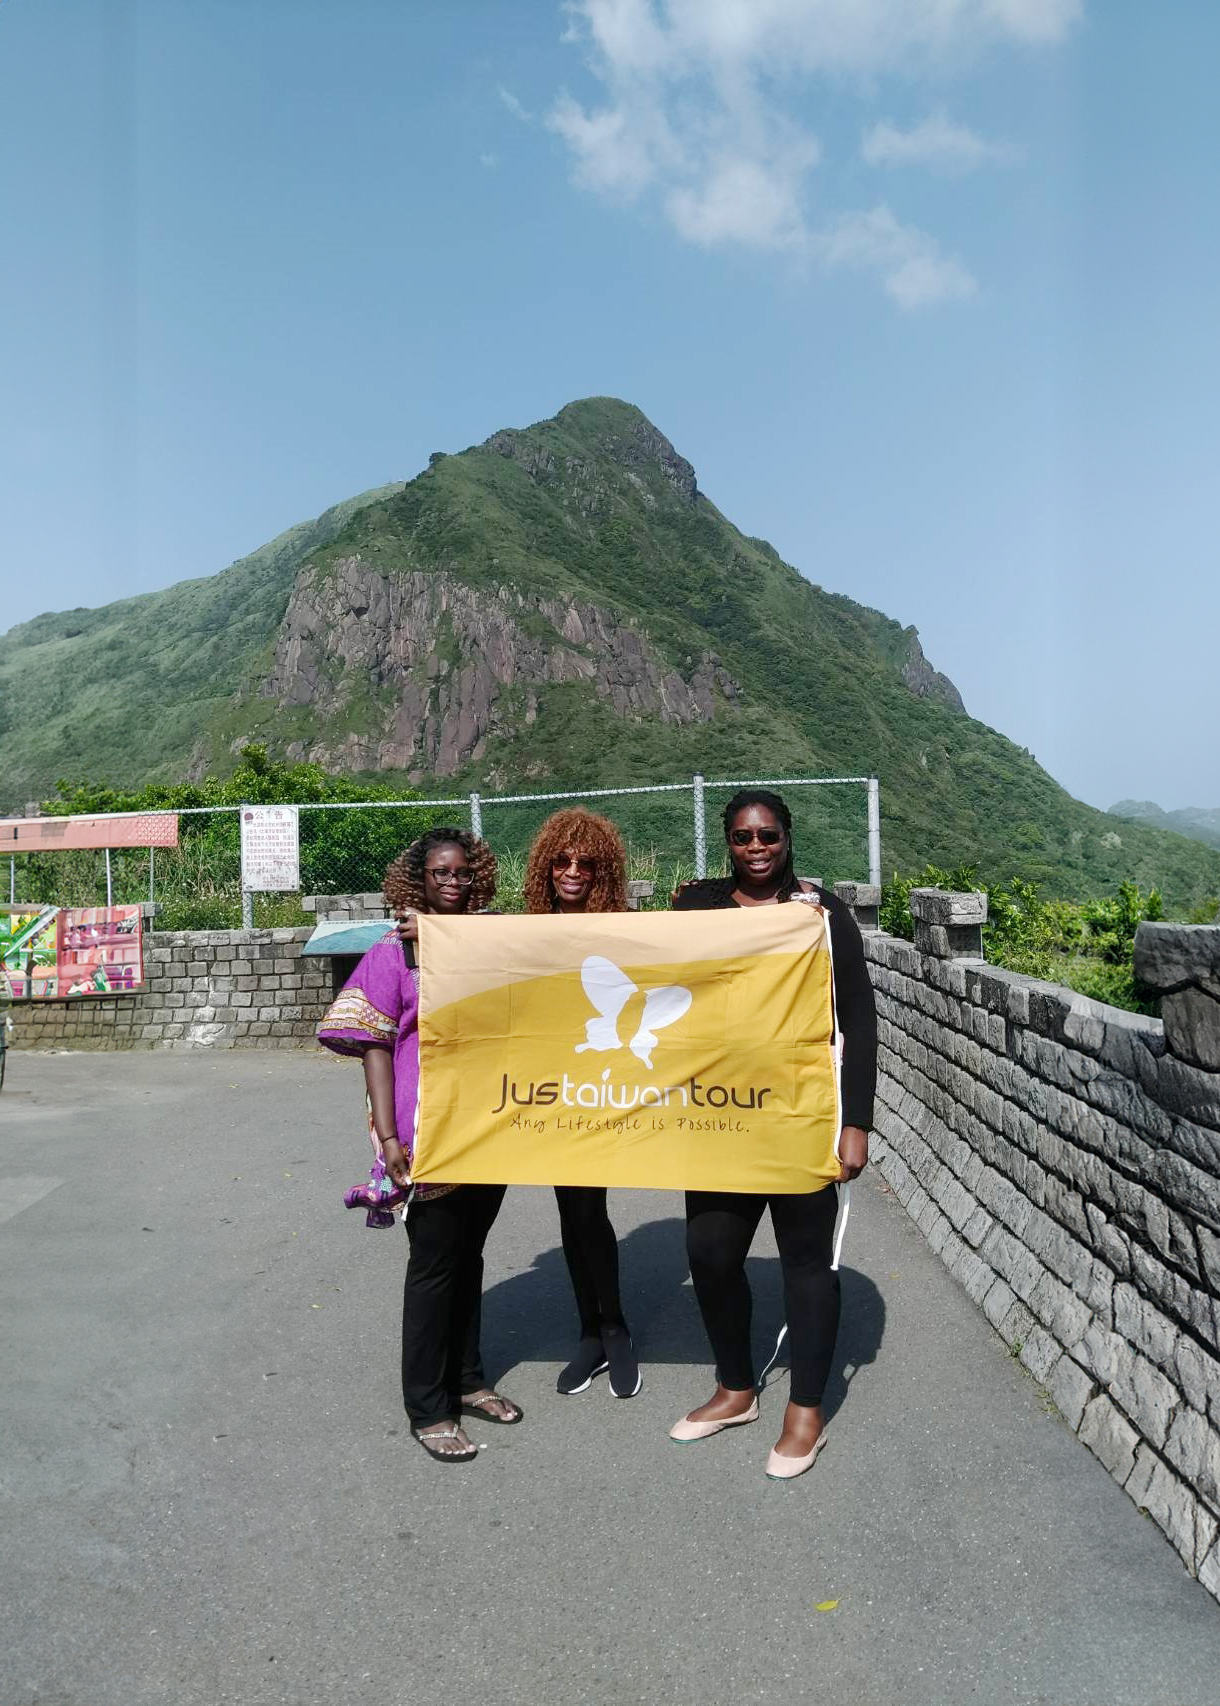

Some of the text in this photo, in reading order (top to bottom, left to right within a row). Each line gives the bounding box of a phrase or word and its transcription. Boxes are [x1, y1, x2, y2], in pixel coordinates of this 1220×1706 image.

[510, 1113, 750, 1134] Any Lifestyle is Possible.
